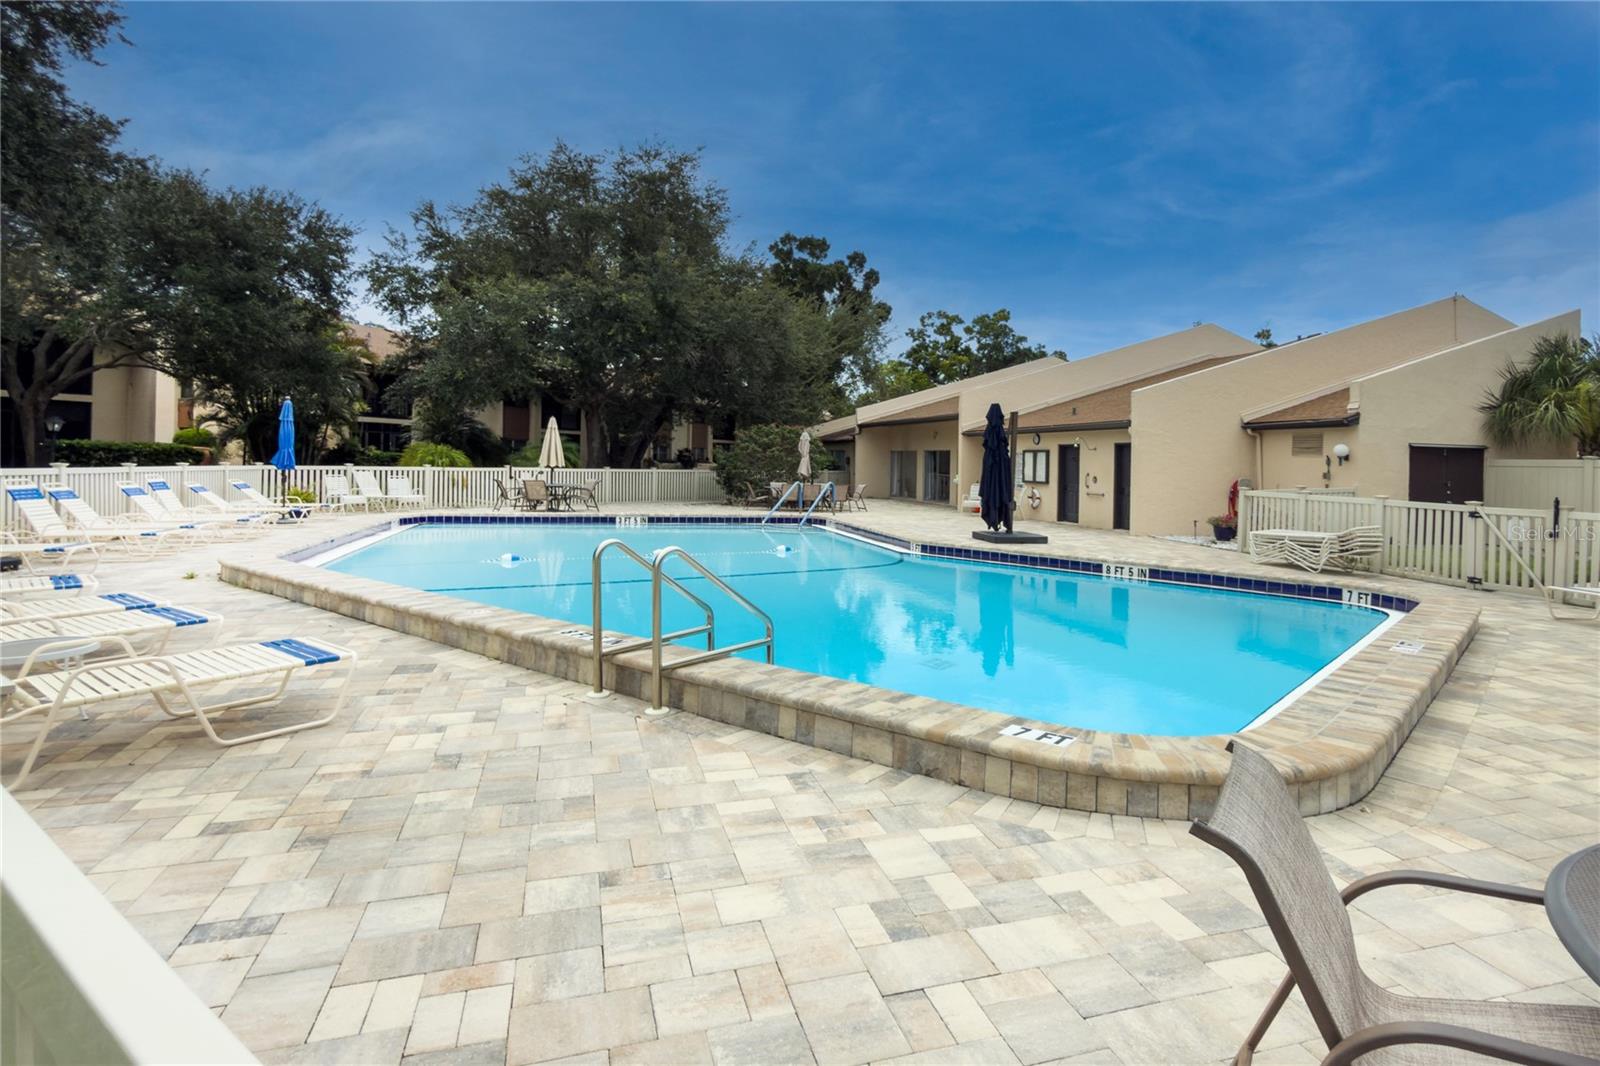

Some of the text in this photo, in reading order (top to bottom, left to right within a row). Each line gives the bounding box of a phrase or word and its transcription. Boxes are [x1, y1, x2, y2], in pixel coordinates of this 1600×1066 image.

[1105, 564, 1147, 579] 8 FT 5 IN
[1347, 590, 1370, 605] 7 FT
[1012, 726, 1074, 745] 7 FT
